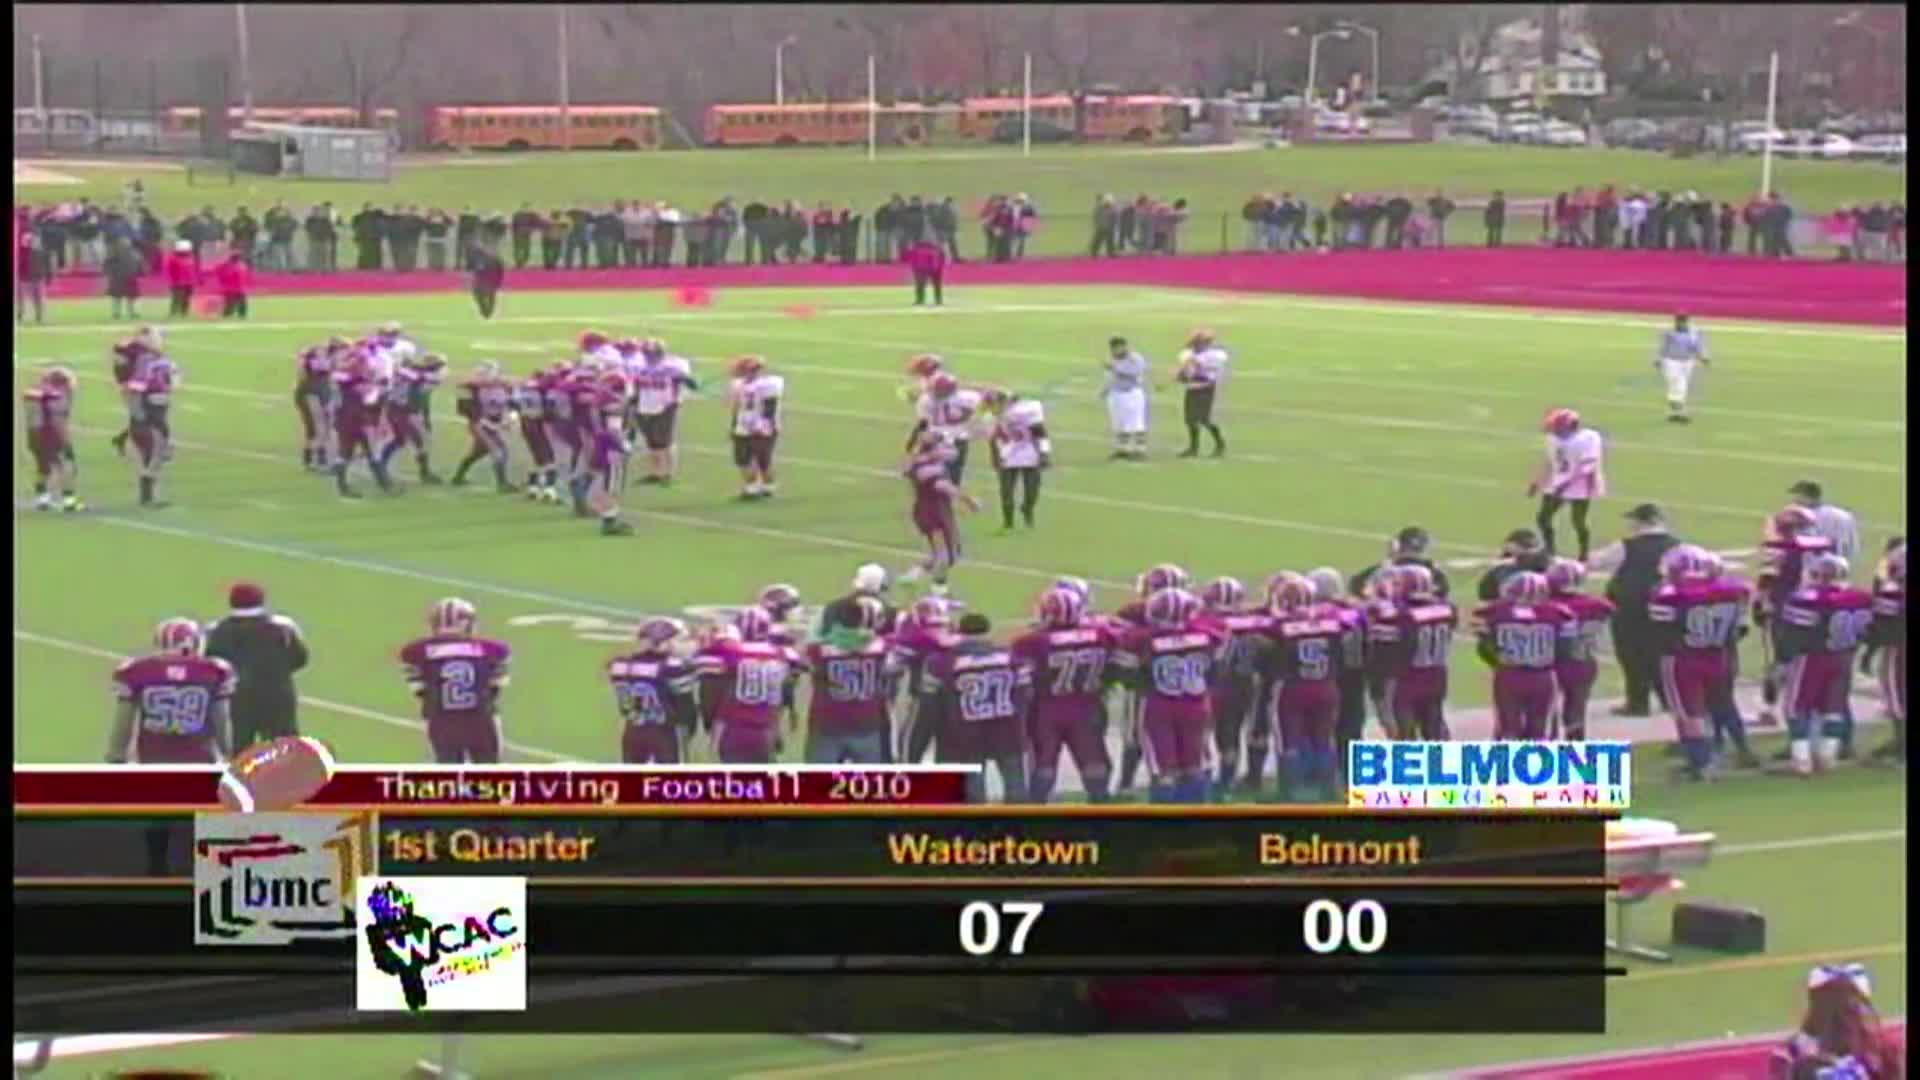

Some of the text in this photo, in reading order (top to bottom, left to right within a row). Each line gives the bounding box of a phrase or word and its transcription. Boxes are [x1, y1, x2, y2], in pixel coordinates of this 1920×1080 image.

[143, 685, 209, 734] 59
[441, 660, 477, 711] 2
[955, 669, 1015, 720] 27
